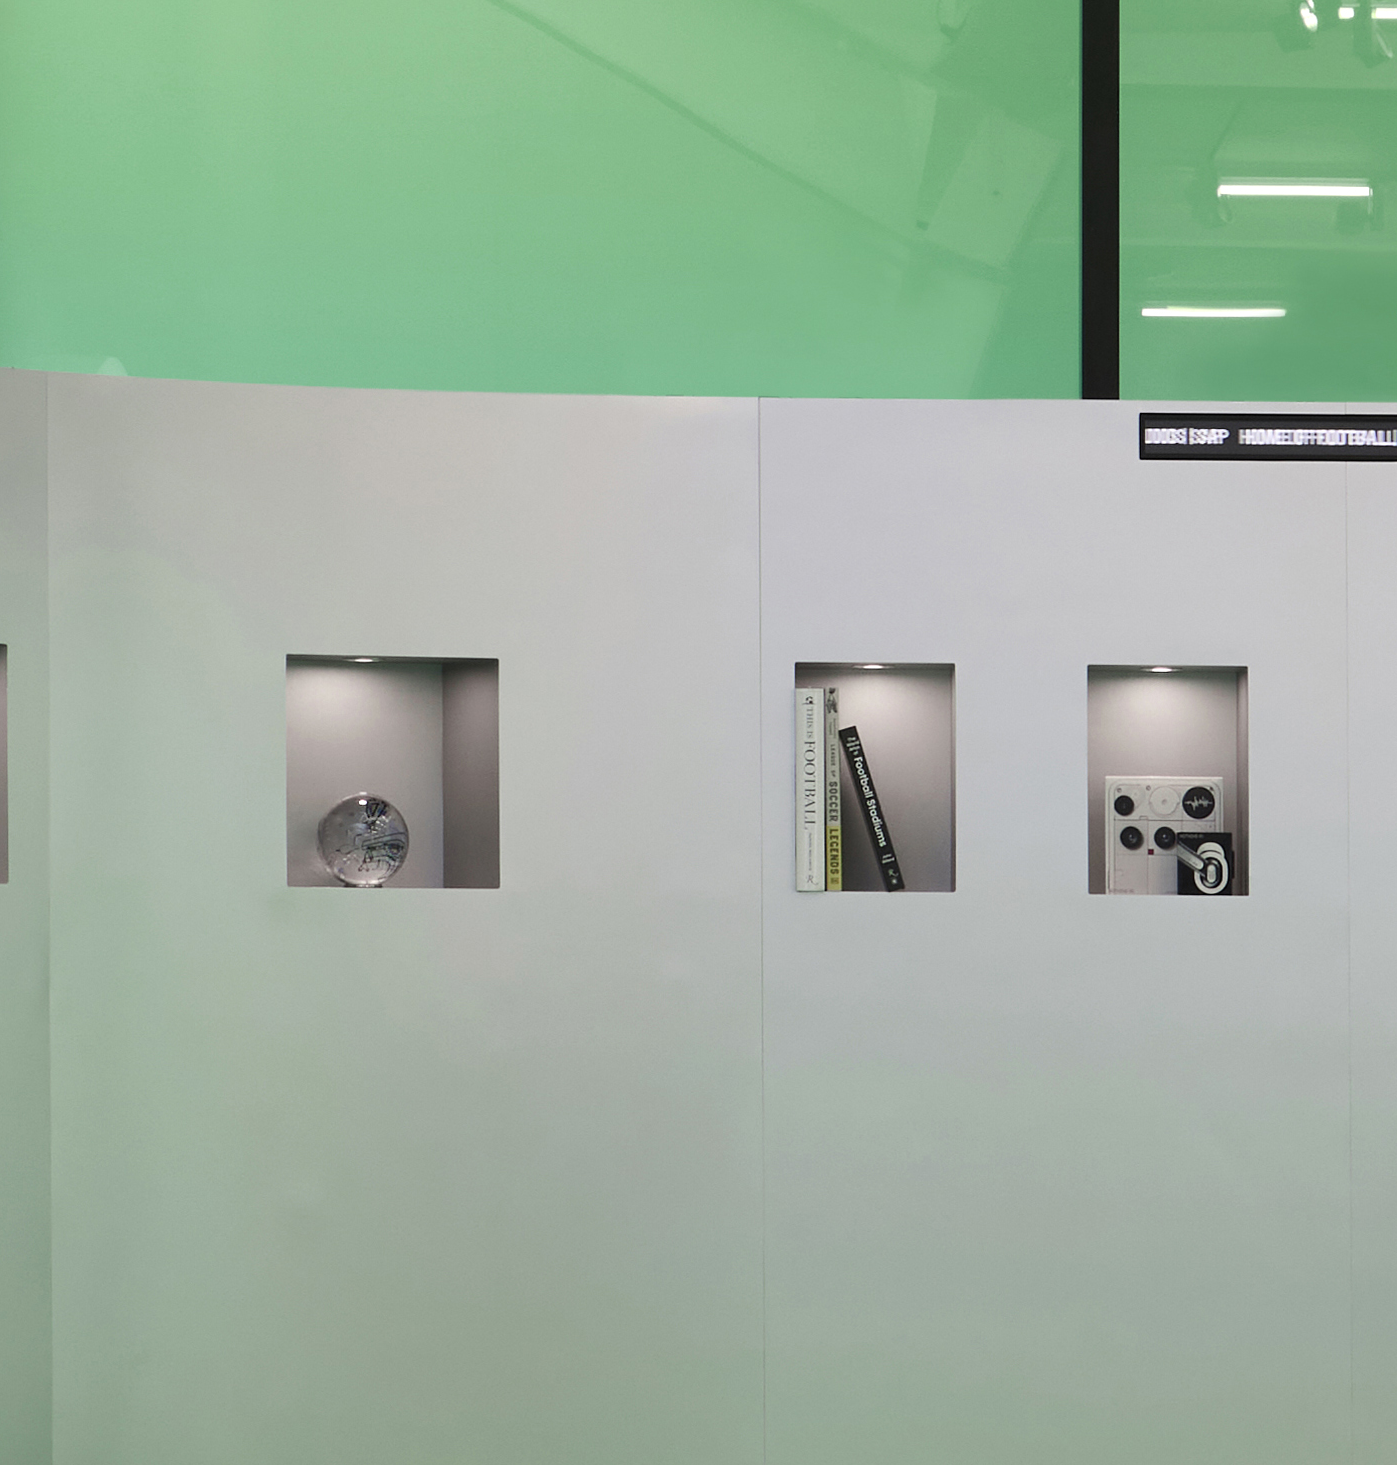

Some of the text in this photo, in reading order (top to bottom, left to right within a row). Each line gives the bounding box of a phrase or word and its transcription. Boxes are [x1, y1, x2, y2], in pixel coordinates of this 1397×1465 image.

[806, 707, 814, 729] THIS
[806, 731, 814, 739] IS
[804, 741, 816, 830] FOOTBALL
[829, 781, 839, 822] SOCCER
[853, 756, 887, 848] Football Stadiums
[829, 828, 840, 875] LEGENDS
